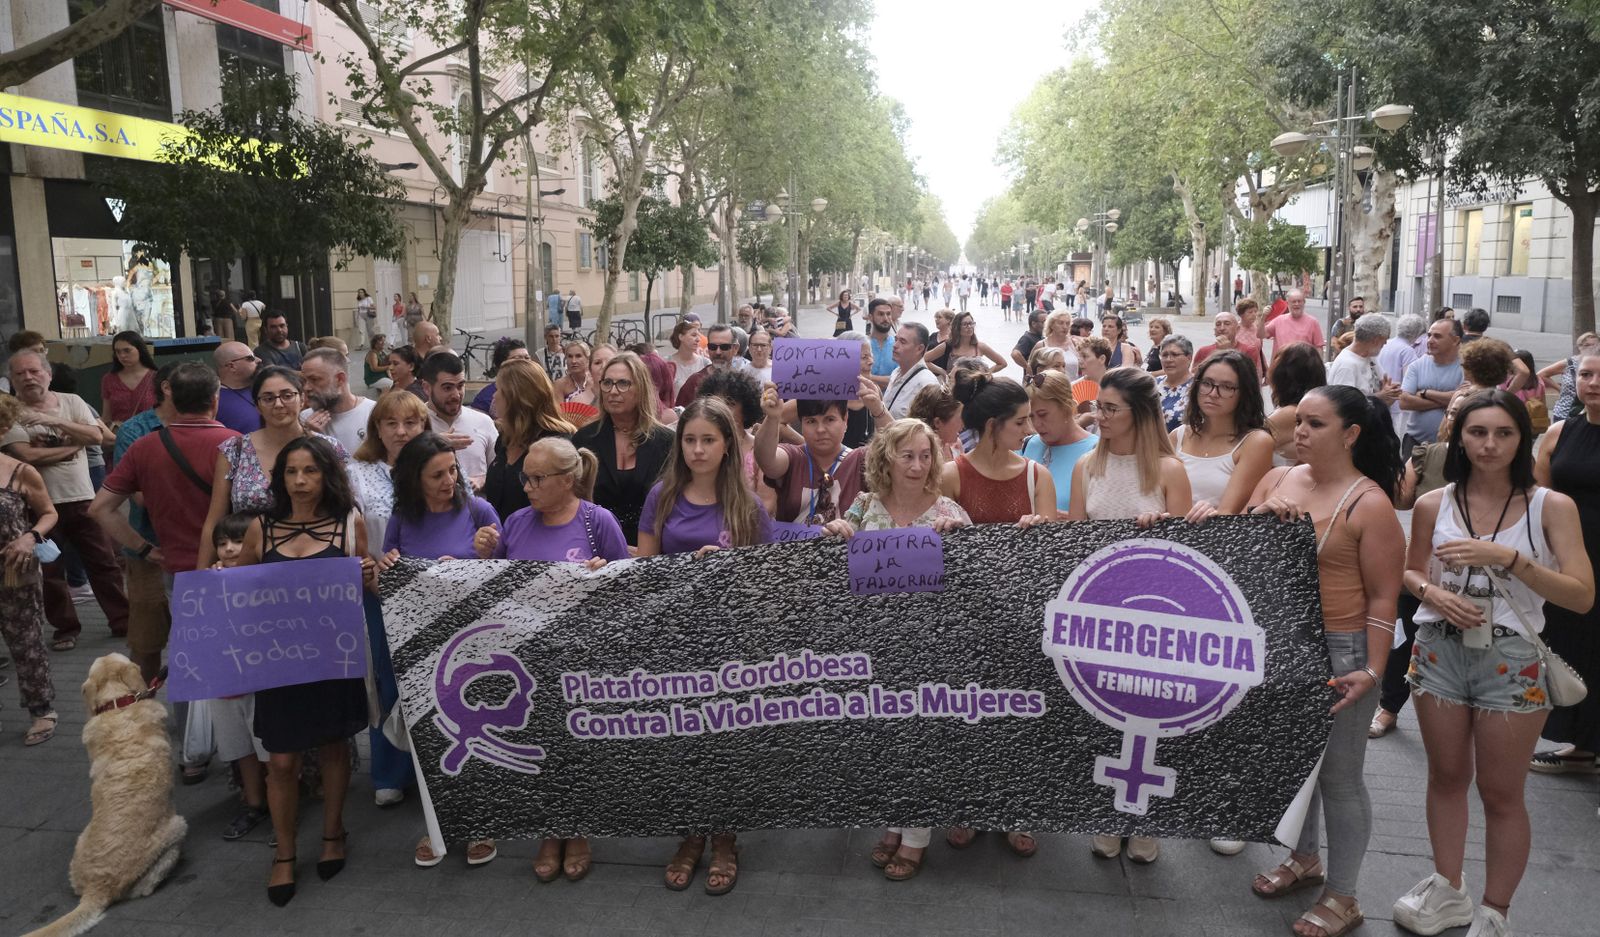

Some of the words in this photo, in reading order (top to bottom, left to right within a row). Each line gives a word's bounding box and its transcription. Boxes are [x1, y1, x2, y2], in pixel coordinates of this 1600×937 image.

[774, 345, 850, 361] CONTRA
[792, 364, 821, 379] LA
[776, 382, 857, 395] FALOCRACIA
[850, 534, 937, 554] CONTRA
[874, 557, 902, 573] LA
[854, 571, 945, 592] FALOCRACIA
[181, 587, 207, 617] Si
[216, 578, 289, 612] tocan
[318, 582, 362, 606] una,
[176, 625, 218, 641] nos
[226, 616, 308, 637] tocan
[1051, 612, 1255, 672] EMERGENCIA
[222, 639, 320, 674] todas
[564, 671, 715, 700] Plataforma
[721, 652, 868, 690] Cordobesa
[1096, 670, 1197, 704] FEMINISTA
[569, 711, 667, 736] Contra
[673, 707, 701, 733] la
[705, 691, 841, 730] Violencia
[848, 695, 866, 715] a
[872, 687, 914, 715] las
[922, 686, 1043, 721] Mujeres
